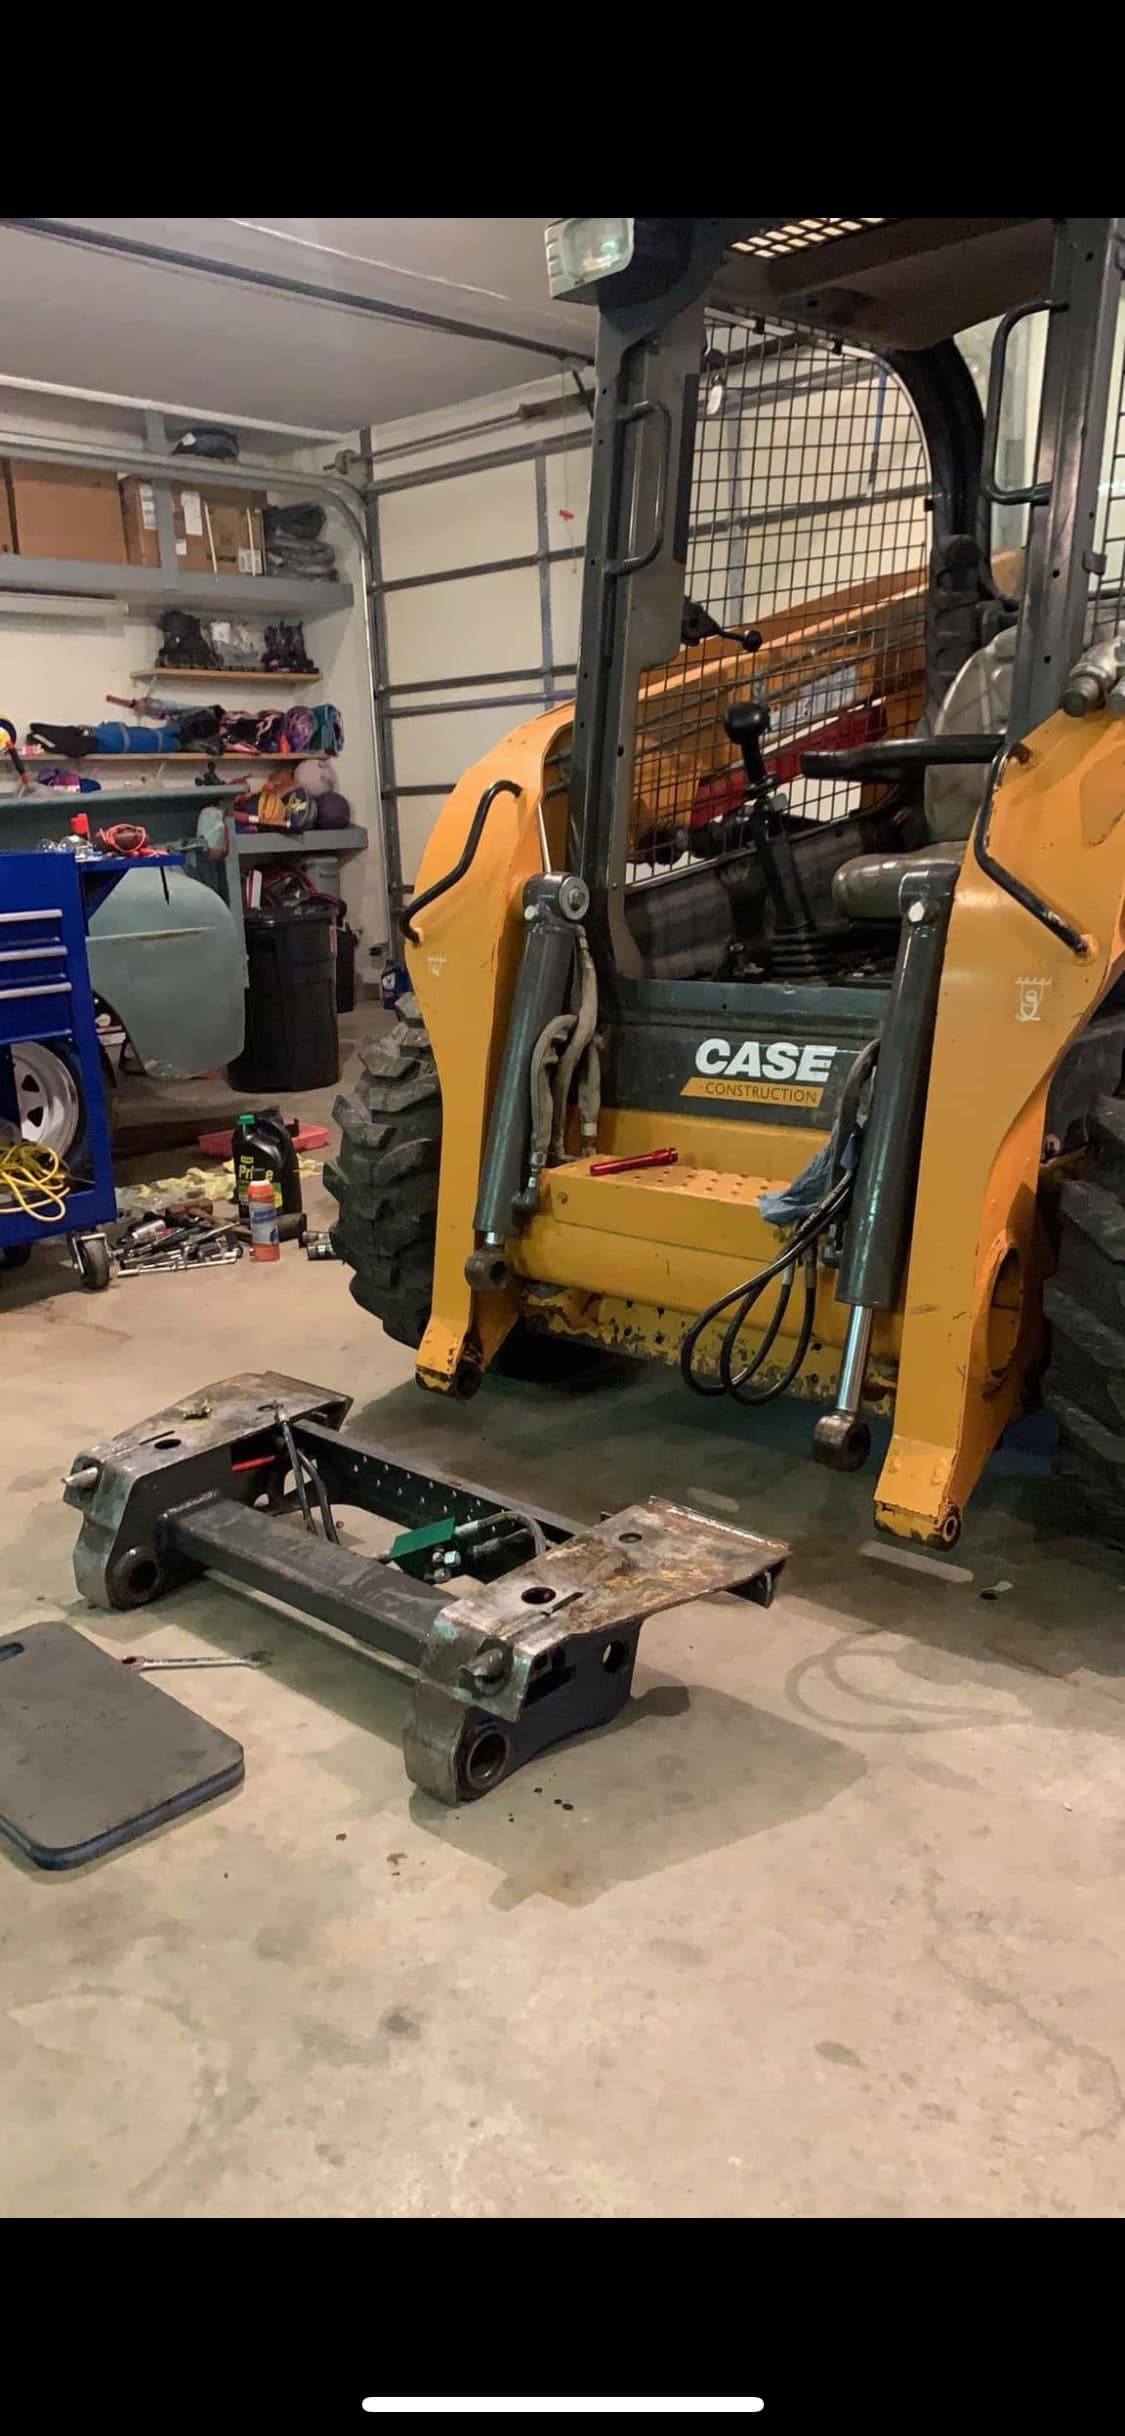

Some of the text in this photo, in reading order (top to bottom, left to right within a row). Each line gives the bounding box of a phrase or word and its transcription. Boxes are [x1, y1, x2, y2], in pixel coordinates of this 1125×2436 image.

[695, 1038, 837, 1082] CASE
[705, 1082, 817, 1102] CONSTRUCTION
[239, 1165, 274, 1181] Prie
